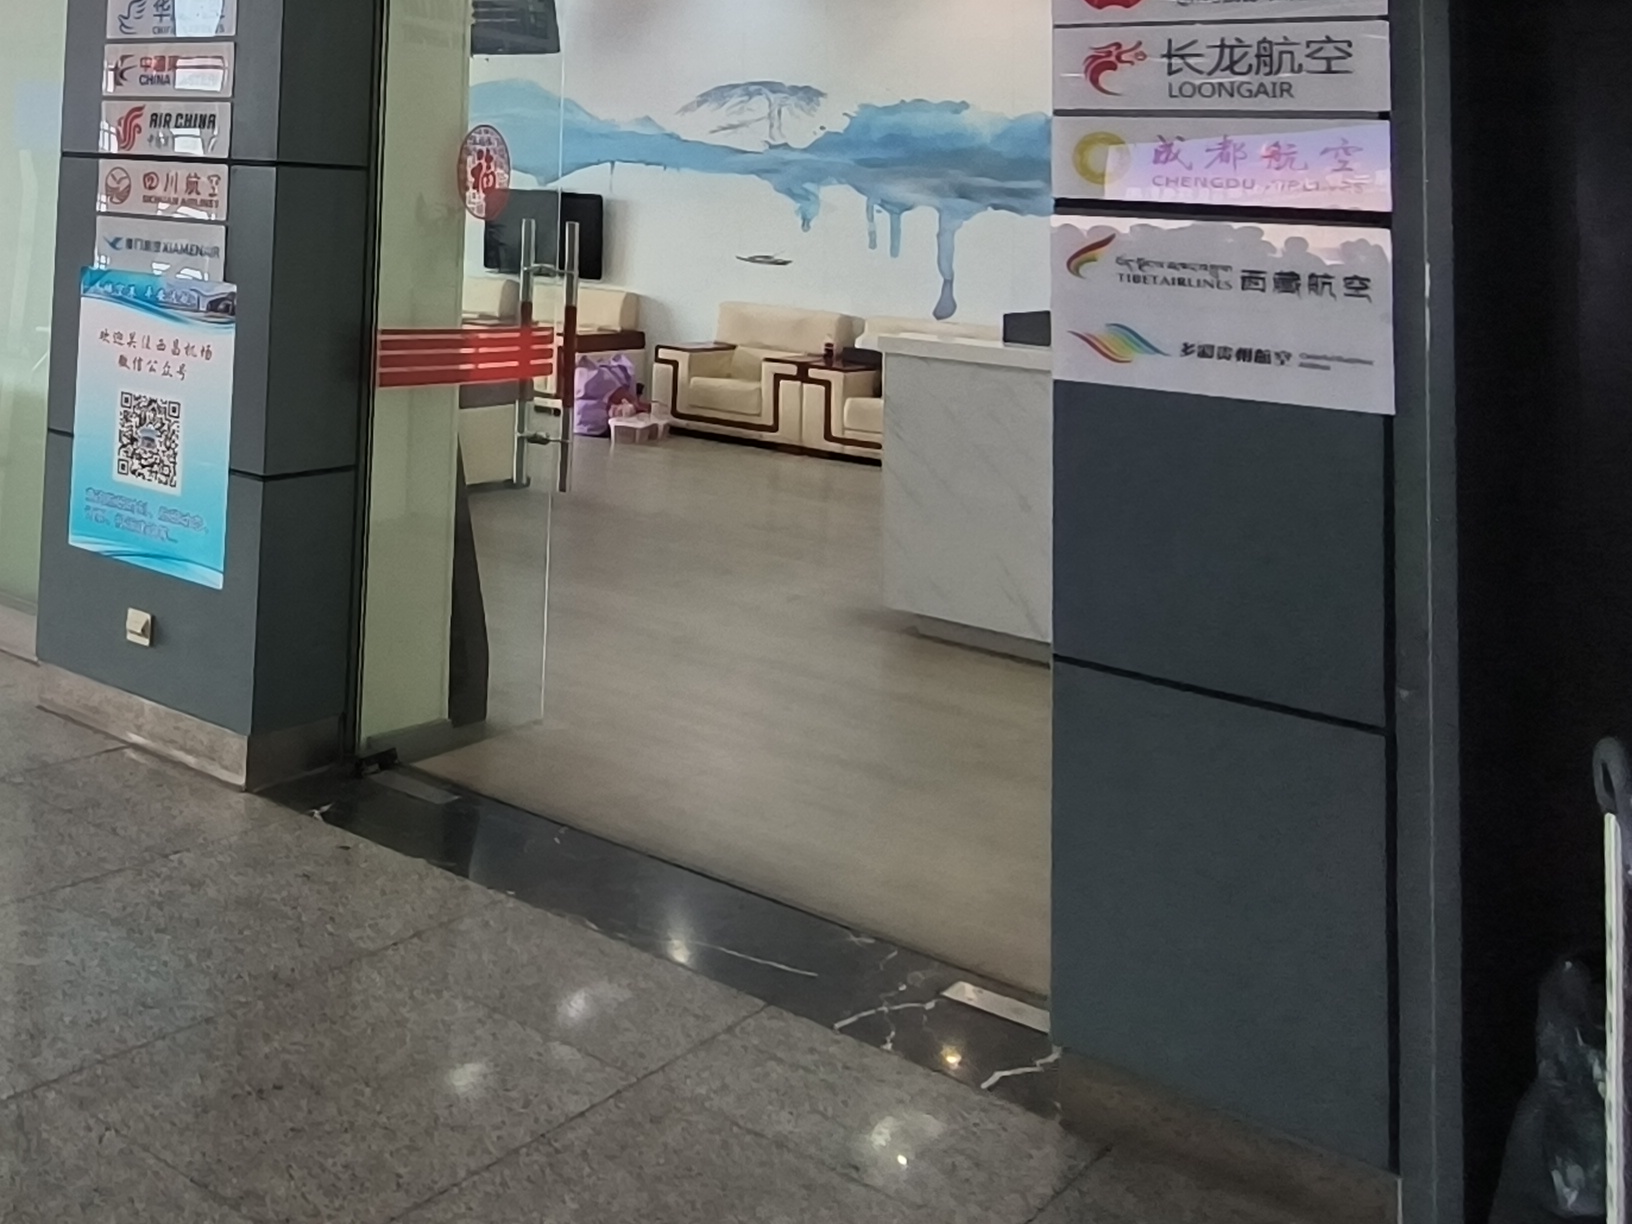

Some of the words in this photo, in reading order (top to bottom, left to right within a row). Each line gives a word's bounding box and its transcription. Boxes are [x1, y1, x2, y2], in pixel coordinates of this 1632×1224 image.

[1160, 34, 1354, 76] 长龙航空
[1168, 80, 1295, 99] LOONGAIR
[149, 112, 172, 129] AIR
[174, 112, 217, 130] CHINA
[1152, 134, 1364, 172] 成都航空
[142, 170, 222, 198] 四川航空
[1152, 175, 1256, 190] CHENGDU
[1240, 269, 1373, 303] 西藏航空
